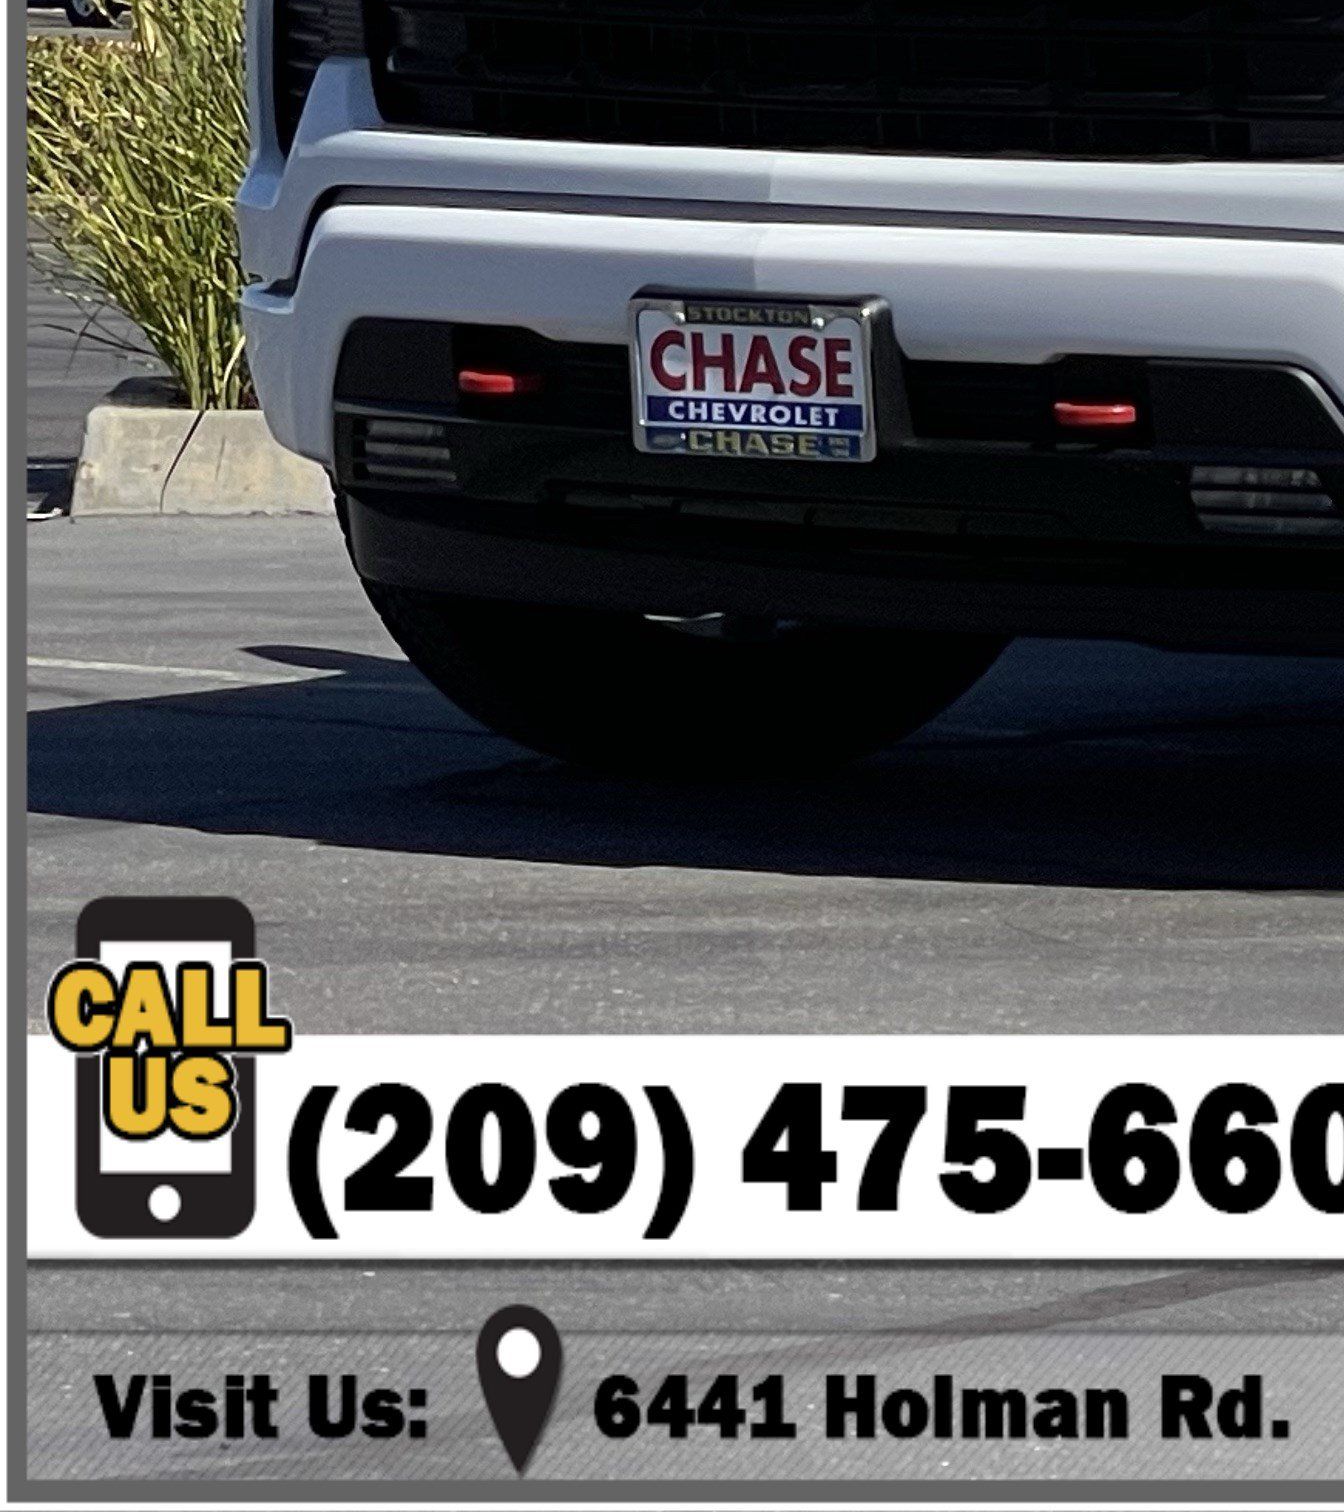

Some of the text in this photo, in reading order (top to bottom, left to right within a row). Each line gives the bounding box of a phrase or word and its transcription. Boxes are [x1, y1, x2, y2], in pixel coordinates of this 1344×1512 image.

[686, 305, 811, 326] STOCKTON
[650, 329, 855, 399] CHASE
[668, 400, 840, 427] CHEVROLET
[688, 429, 819, 457] CHASE
